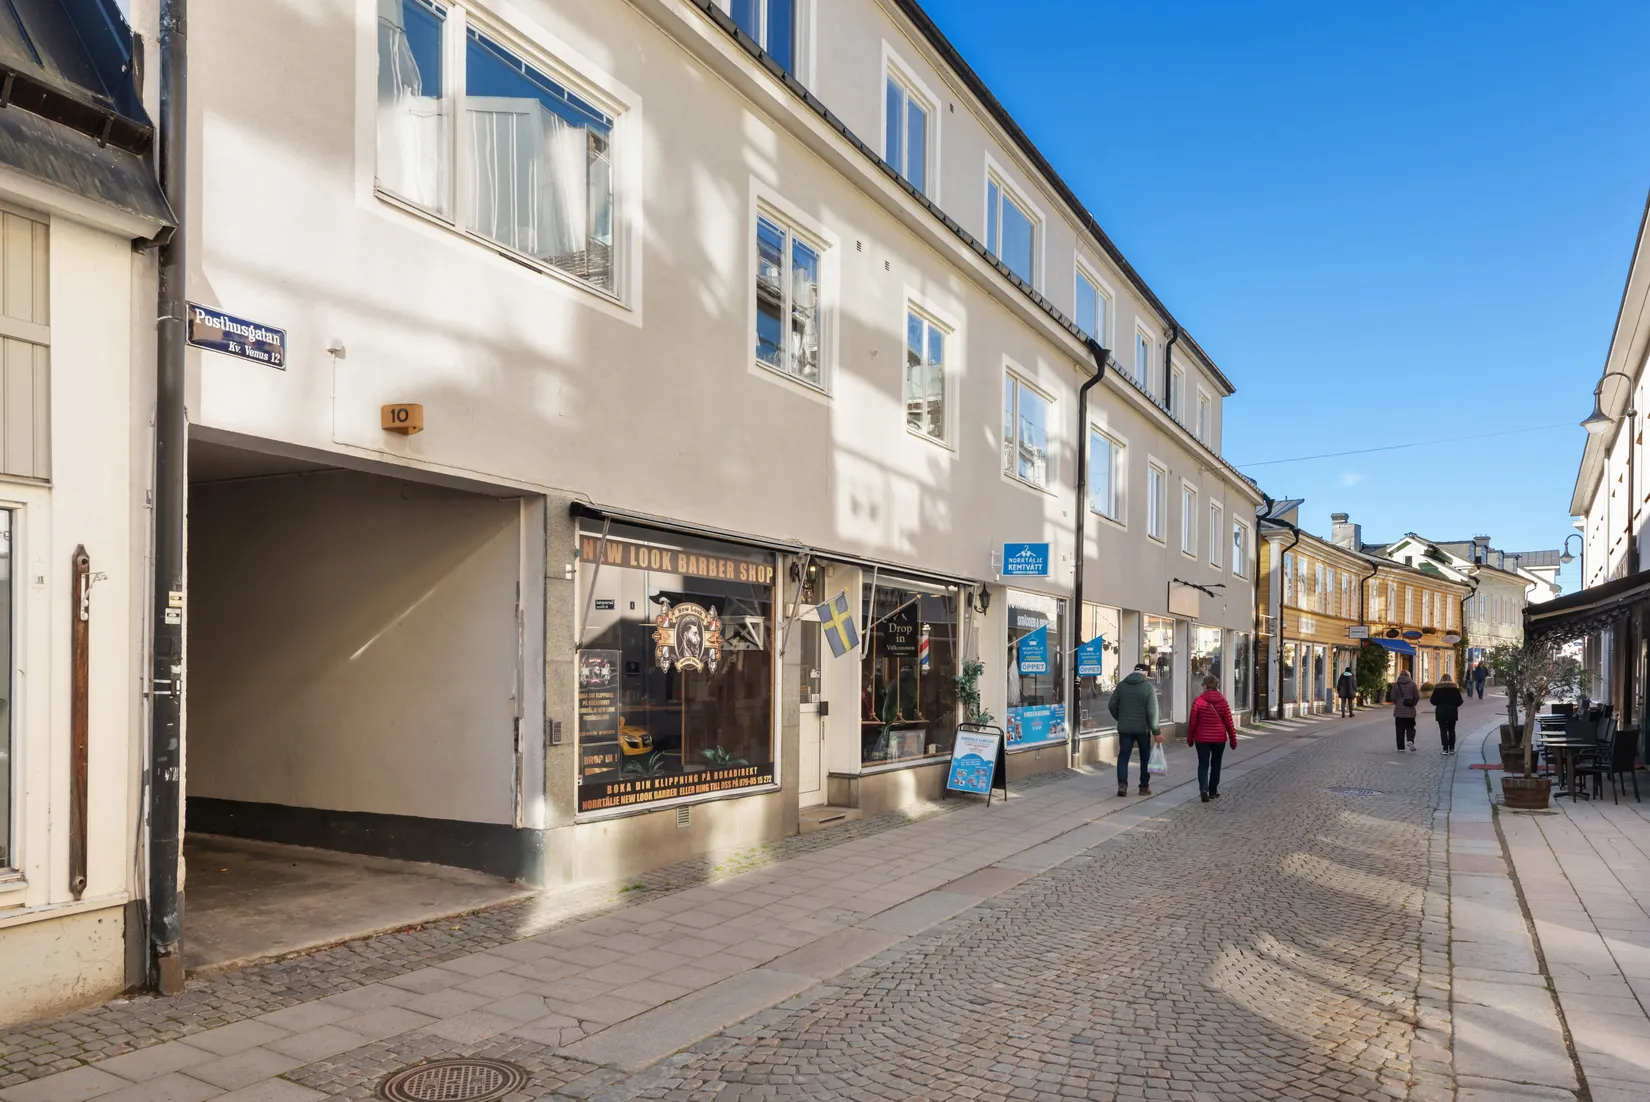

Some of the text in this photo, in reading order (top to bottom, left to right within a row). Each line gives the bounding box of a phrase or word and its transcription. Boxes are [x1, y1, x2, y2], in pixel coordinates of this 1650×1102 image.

[194, 308, 281, 346] Posthusgatan
[228, 341, 281, 363] Kv. Venus 12
[390, 408, 409, 423] 10
[630, 545, 672, 570] LOOK
[678, 553, 735, 579] BARBER
[740, 563, 774, 584] SHOP
[1008, 563, 1043, 571] KEMTVÄTT
[888, 622, 913, 635] Drop
[896, 633, 905, 643] in
[1022, 662, 1045, 670] ÖPPET
[584, 754, 604, 765] DROP
[607, 766, 758, 794] BOKA DIN KLIPPNING PÅ BOKADIREKT
[582, 796, 620, 810] NORRTÄLJE
[620, 794, 637, 805] NEW
[636, 791, 653, 802] LOOK
[653, 788, 678, 799] BARBER
[679, 785, 695, 795] ELLER
[695, 783, 710, 793] RING
[709, 782, 721, 791] TILL
[720, 780, 732, 790] OSS
[732, 778, 739, 788] PÅ
